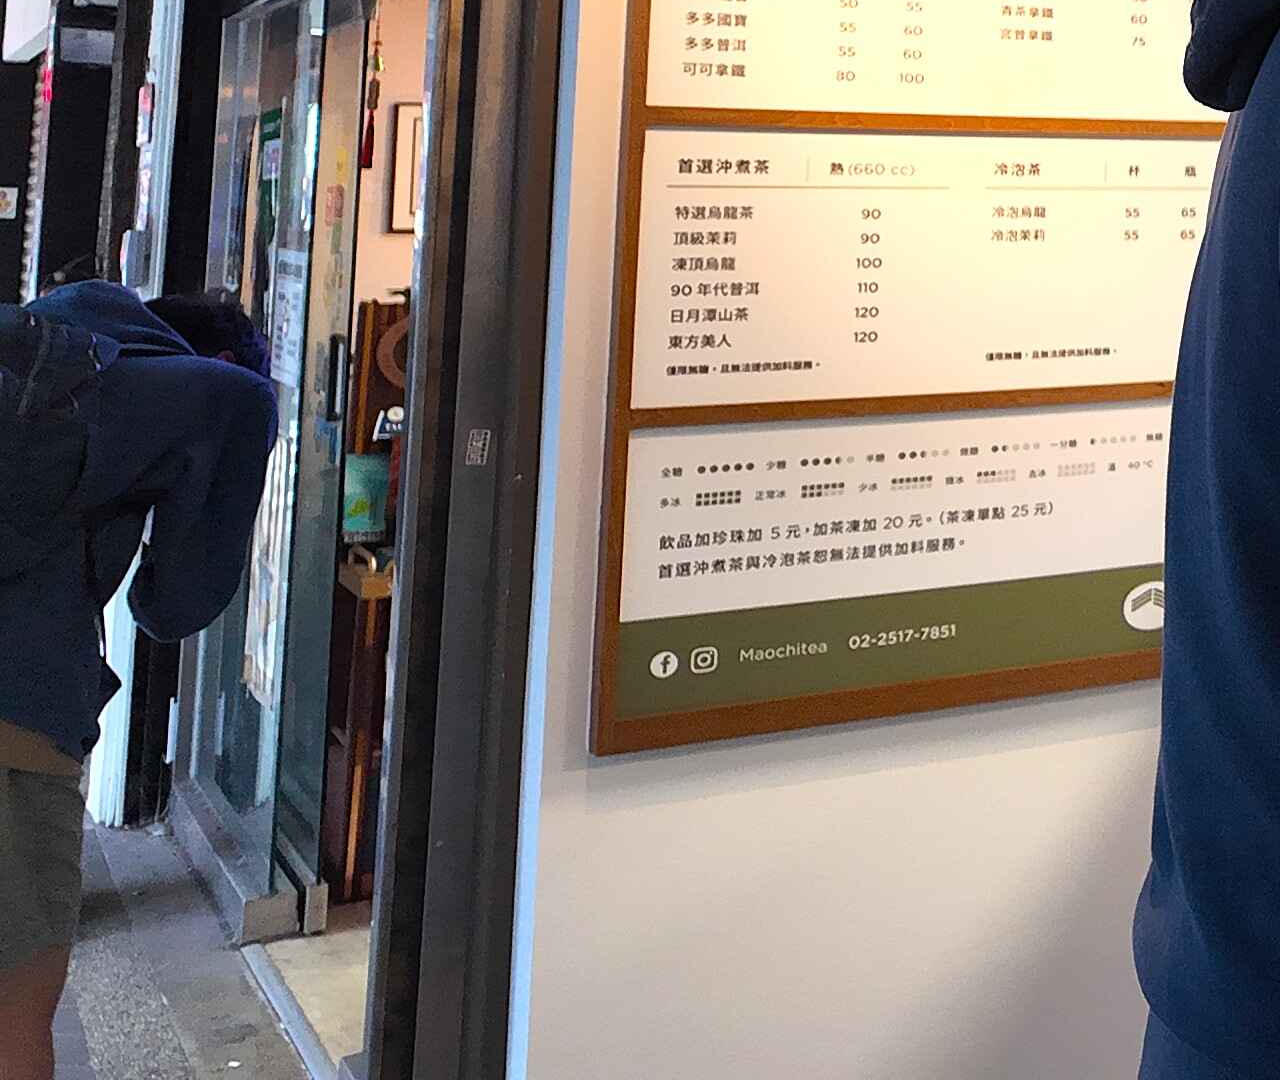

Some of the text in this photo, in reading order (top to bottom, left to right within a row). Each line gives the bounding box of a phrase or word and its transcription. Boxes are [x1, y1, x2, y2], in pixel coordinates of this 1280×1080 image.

[1130, 14, 1148, 25] 60
[839, 22, 857, 34] 55
[1131, 36, 1146, 47] 75
[838, 46, 856, 58] 55
[836, 70, 856, 82] 80
[678, 158, 770, 175] 首選沖煮茶
[994, 162, 1041, 177] 冷泡茶
[674, 206, 882, 220] 特選烏龍茶 90
[1125, 208, 1140, 218] 55
[1181, 208, 1196, 218] 65
[673, 232, 880, 246] 頂級茉莉 90
[1124, 230, 1139, 241] 55
[1180, 230, 1195, 240] 65
[671, 257, 882, 271] 凍頂烏龍 100
[858, 282, 879, 294] 110
[671, 307, 879, 324] 日月潭山茶 120
[667, 331, 878, 350] 東方美人 120
[659, 528, 762, 551] 飲品加珍珠加
[771, 527, 780, 540] 5
[884, 517, 903, 528] 20
[1011, 505, 1029, 517] 25
[740, 624, 957, 663] Maochitea 02-2517-7851
